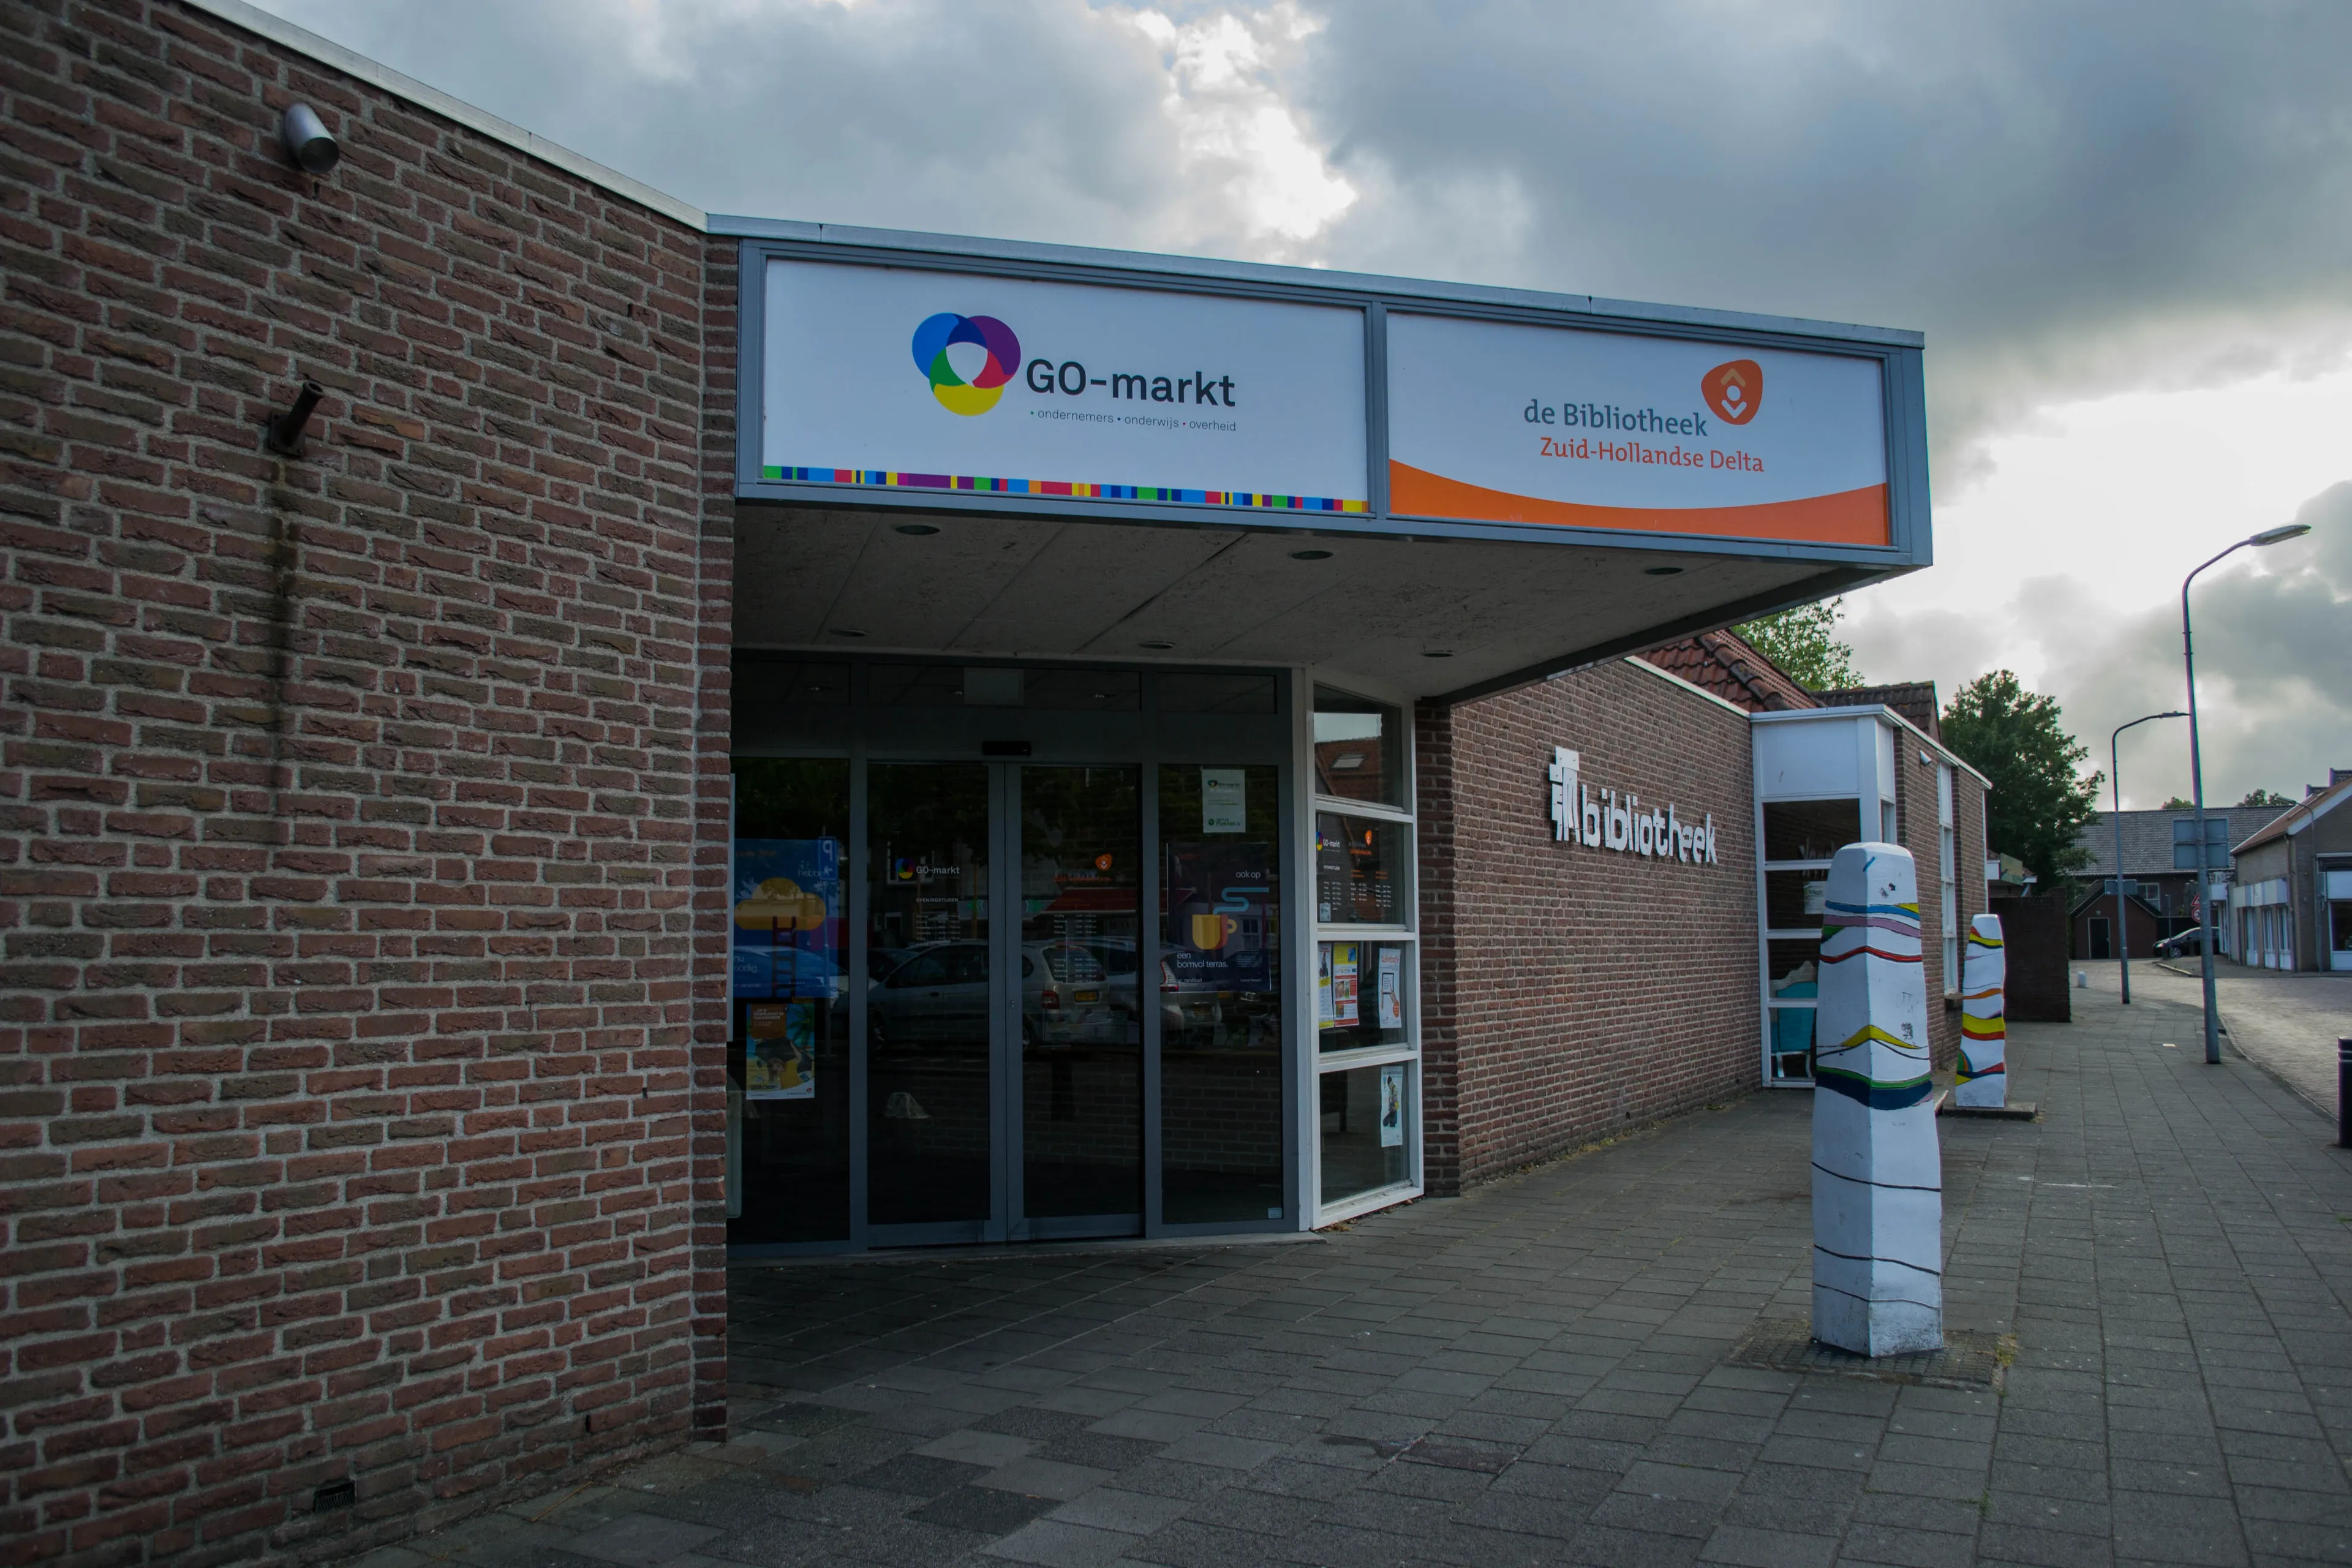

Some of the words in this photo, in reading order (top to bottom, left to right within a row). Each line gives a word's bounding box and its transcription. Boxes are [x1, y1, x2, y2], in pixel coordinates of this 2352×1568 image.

[1026, 358, 1236, 407] GO-markt
[1038, 409, 1114, 423] ondernemers
[1124, 415, 1180, 430] onderwijs
[1189, 419, 1237, 432] overheid
[1524, 398, 1556, 424] de
[1564, 403, 1708, 437] Bibliotheek
[1540, 436, 1705, 468] Zuid-Hollandse
[1710, 450, 1765, 472] Delta
[1581, 783, 1717, 864] bibliotheek
[1322, 839, 1340, 848] GO-markt
[916, 865, 960, 875] GO-markt
[1235, 869, 1250, 878] ook
[1250, 871, 1261, 880] op
[1177, 960, 1205, 968] bomvol
